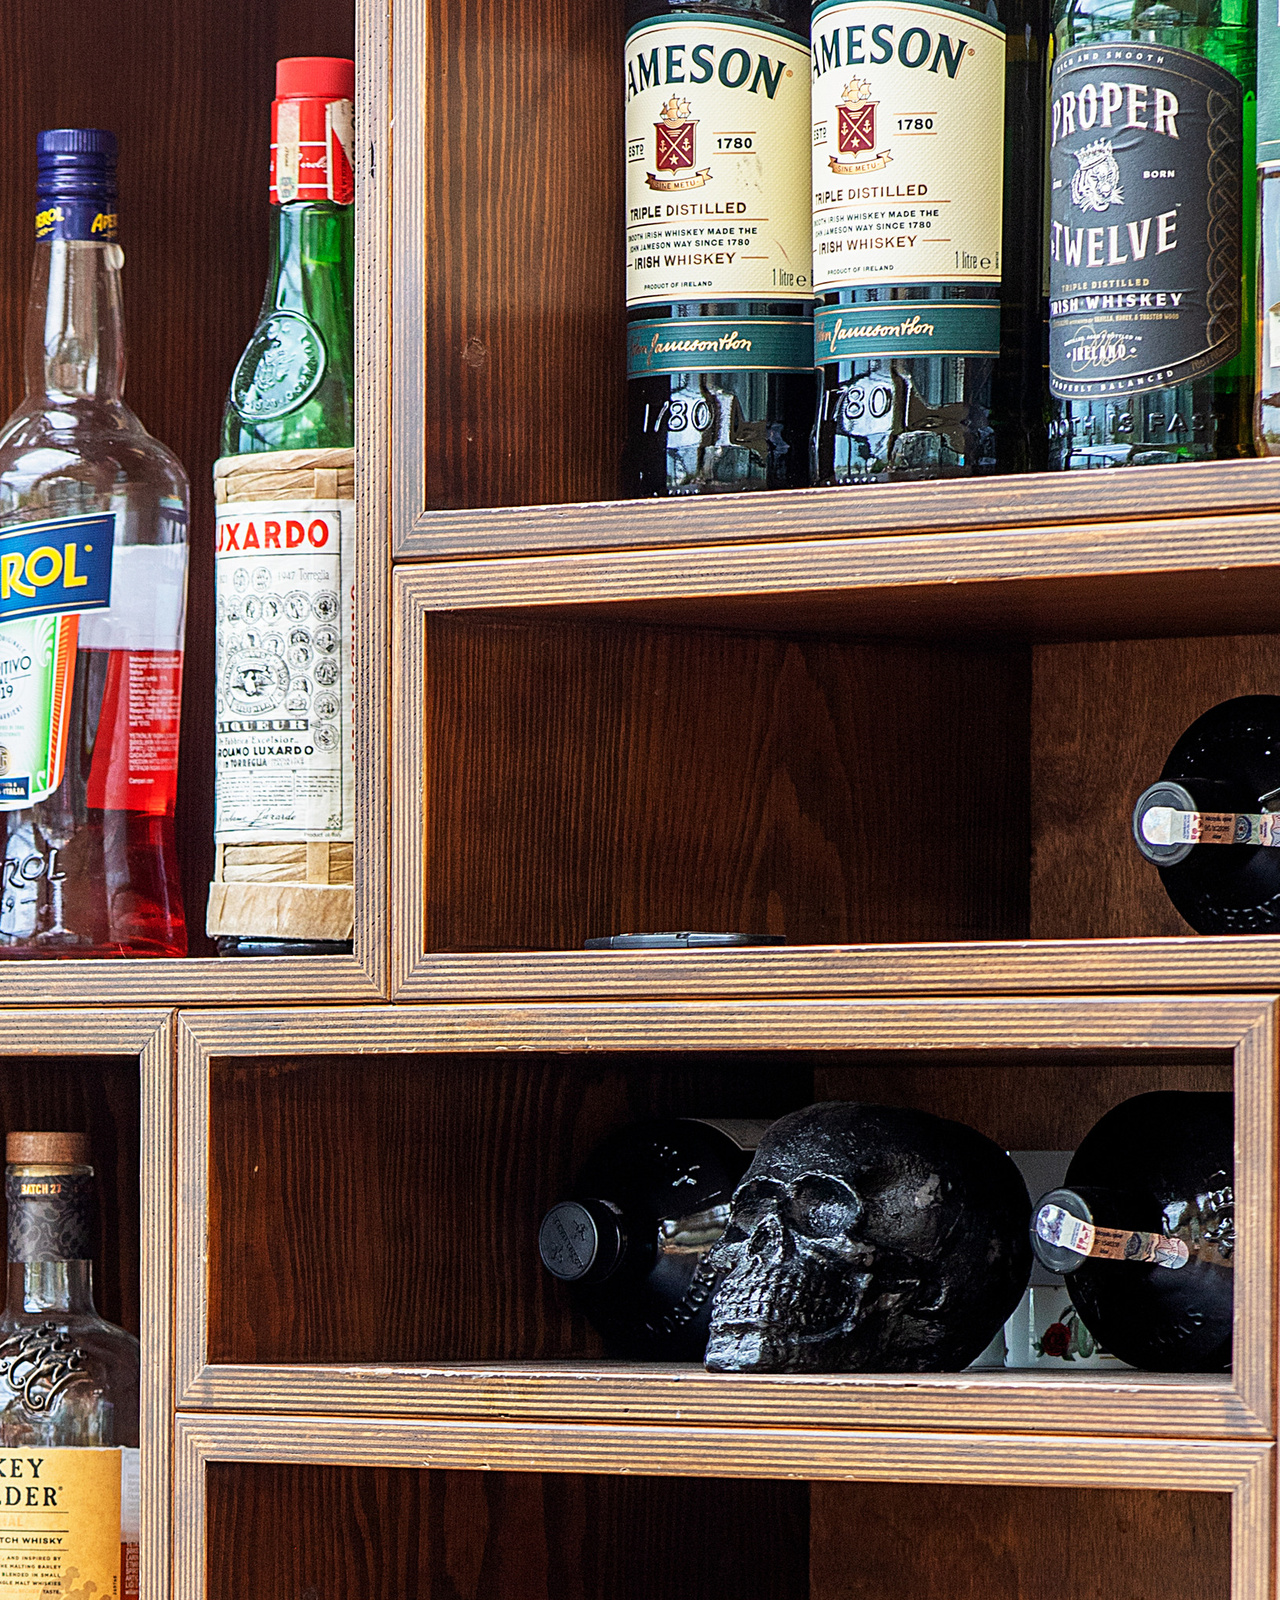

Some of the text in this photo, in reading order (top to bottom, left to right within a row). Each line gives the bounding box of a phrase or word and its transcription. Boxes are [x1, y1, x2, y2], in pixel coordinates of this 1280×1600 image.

[1106, 51, 1165, 65] SMOOTH
[1052, 81, 1180, 147] PROPER
[897, 118, 933, 130] 1780
[717, 138, 752, 149] 1780
[837, 163, 877, 173] SINE METU
[1143, 169, 1175, 179] BORN
[674, 180, 696, 188] METU
[815, 184, 928, 205] TRIPLE DISTILLED
[630, 202, 747, 221] TRIPLE DISTILLED
[847, 211, 886, 221] WHISKEY
[645, 230, 662, 239] IRISH
[665, 229, 705, 237] WHISKEY
[824, 226, 853, 236] JAMESON
[855, 224, 873, 232] WAY
[876, 222, 905, 230] SINCE
[641, 242, 671, 251] JAMESON
[674, 240, 692, 248] WAY
[819, 235, 918, 255] IRISH WHISKEY
[1052, 209, 1178, 268] TWELVE
[635, 252, 736, 270] IRISH WHISKEY
[962, 251, 977, 269] litre
[780, 269, 794, 286] litre
[644, 282, 669, 290] PRODUCT
[1062, 278, 1150, 292] TRIPLE DISTILLED
[1086, 292, 1183, 309] WHISKEY
[1072, 344, 1126, 361] IRELAND
[1101, 370, 1174, 391] BALANCED
[298, 567, 330, 582] Torreglia
[254, 745, 314, 756] LUXARDO
[21, 1184, 48, 1194] BATCH
[22, 1537, 63, 1545] WHISKY
